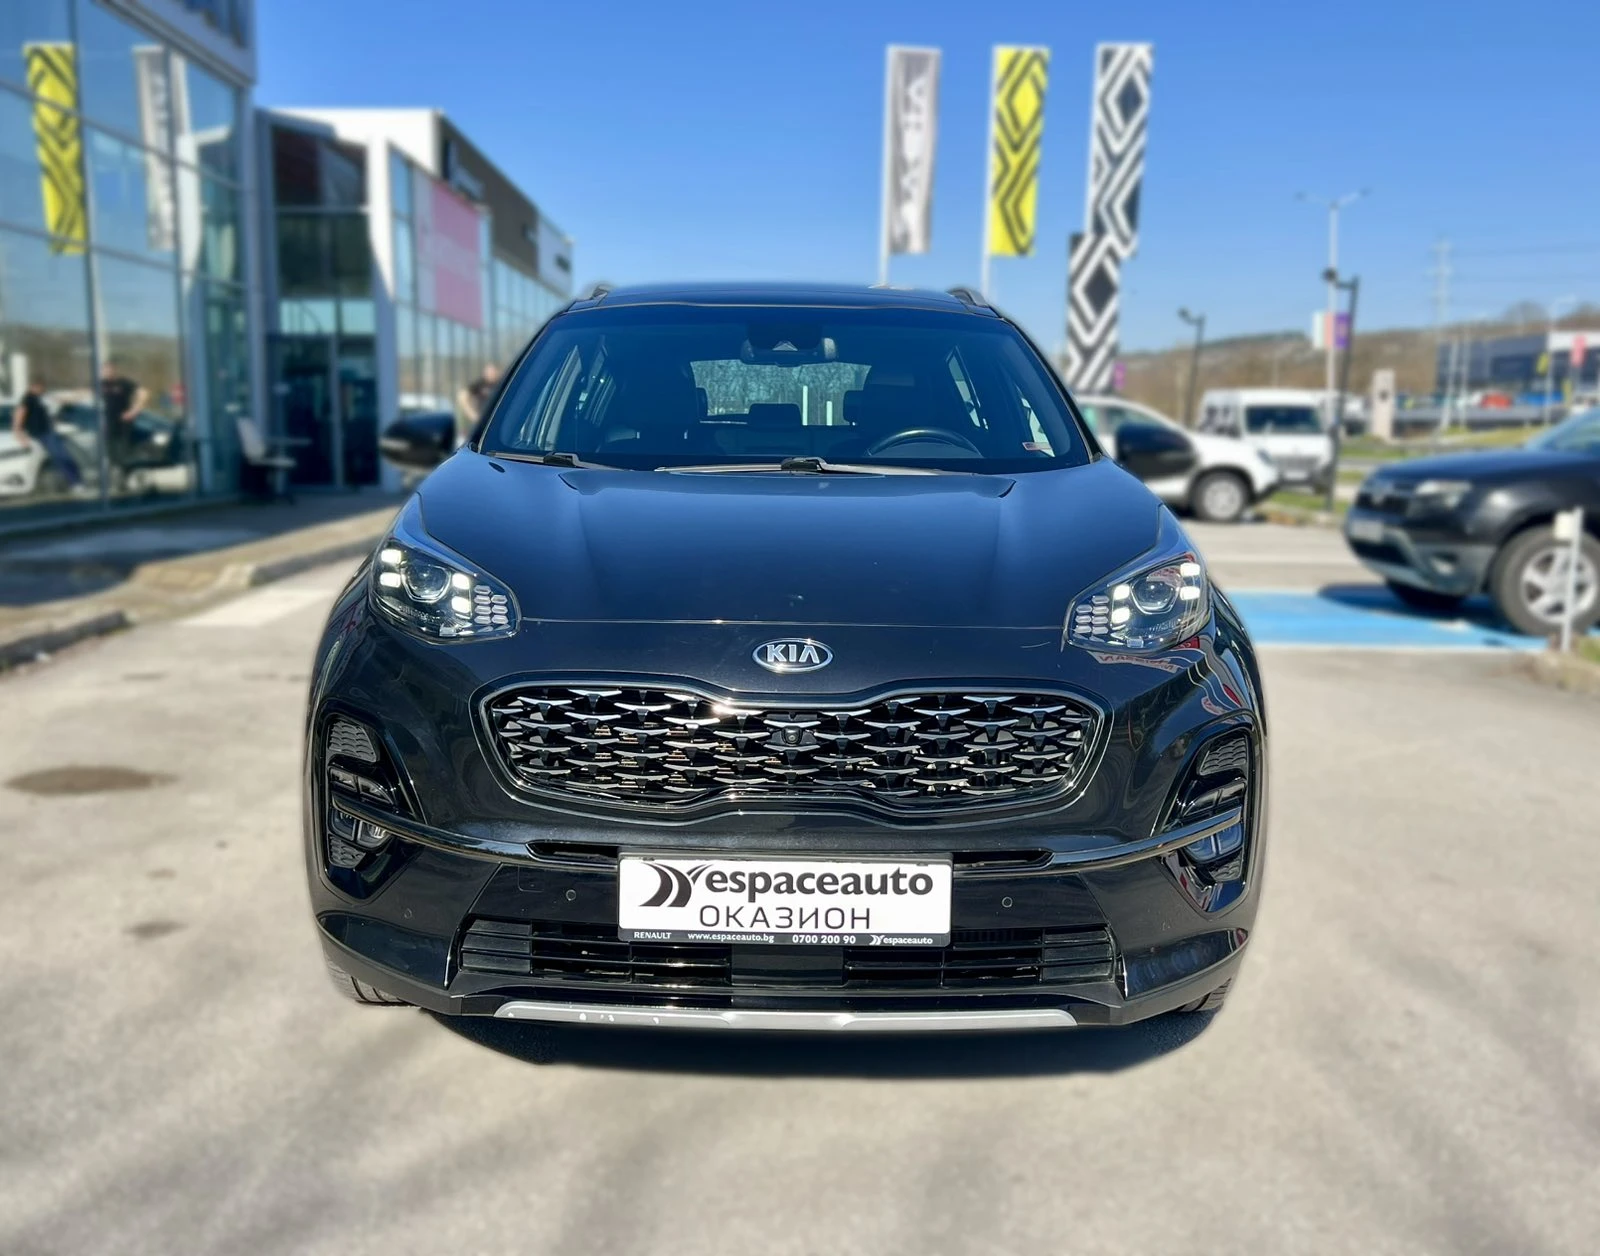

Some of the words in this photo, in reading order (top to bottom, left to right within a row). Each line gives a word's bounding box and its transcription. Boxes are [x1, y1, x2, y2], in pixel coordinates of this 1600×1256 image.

[766, 644, 820, 663] KIA
[705, 866, 934, 903] espaceauto
[699, 905, 870, 930] ОКАЗИОН
[633, 931, 673, 940] RENAULT
[687, 932, 775, 943] www.espaceauto.bg
[792, 934, 818, 944] 0700
[820, 934, 840, 944] 200
[842, 934, 857, 945] 90
[883, 936, 934, 946] espaceauto
